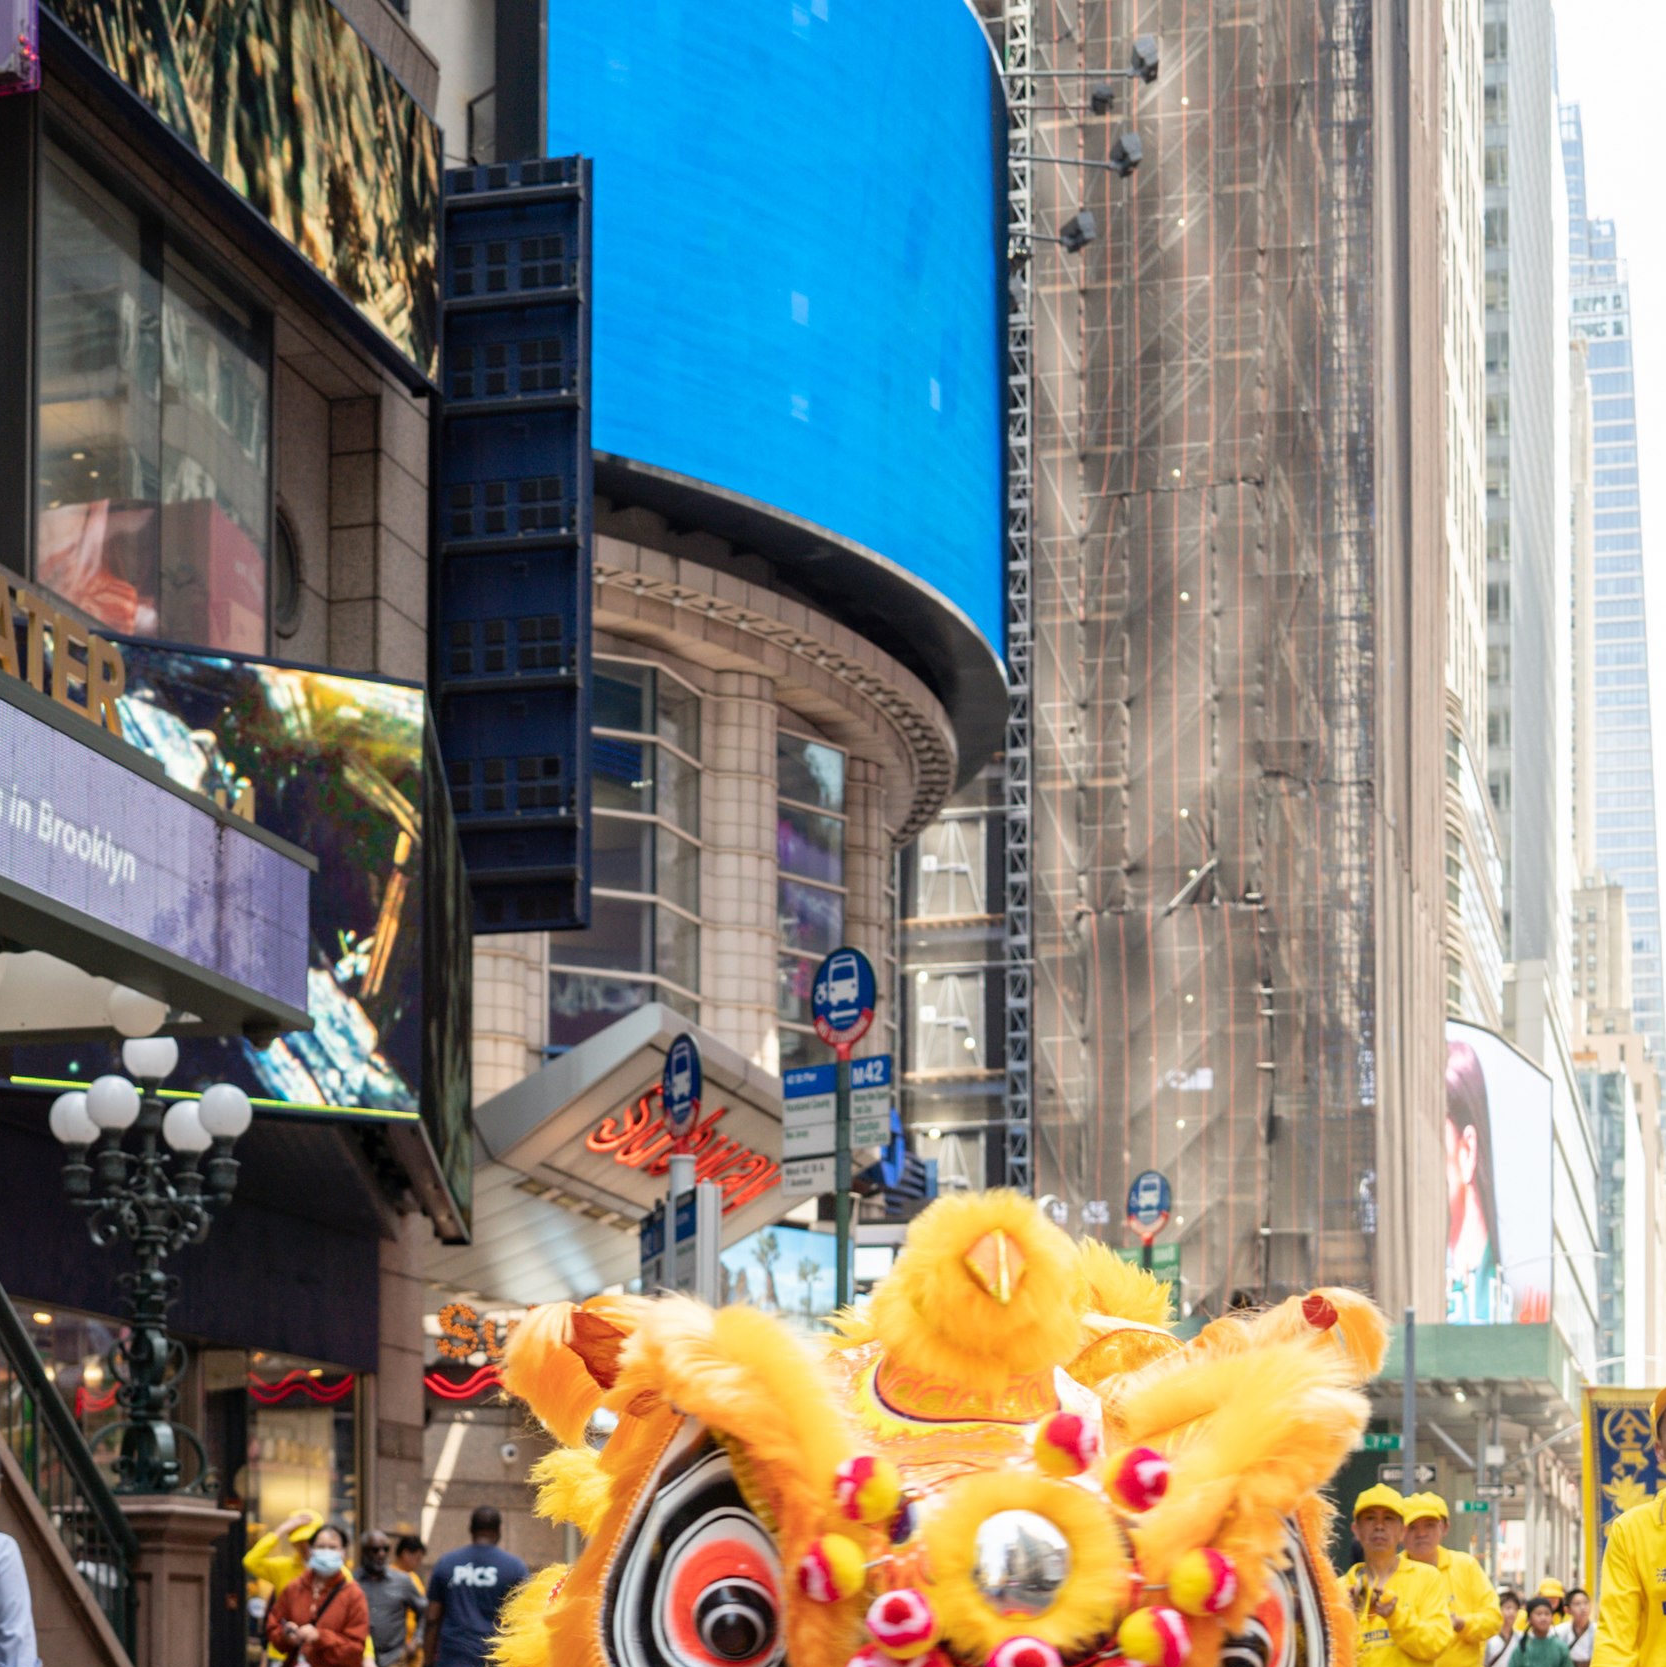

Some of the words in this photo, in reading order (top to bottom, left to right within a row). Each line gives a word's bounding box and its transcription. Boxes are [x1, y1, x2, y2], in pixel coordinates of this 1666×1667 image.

[9, 783, 32, 833] in
[37, 799, 136, 886] Brooklyn
[852, 1059, 884, 1086] M42
